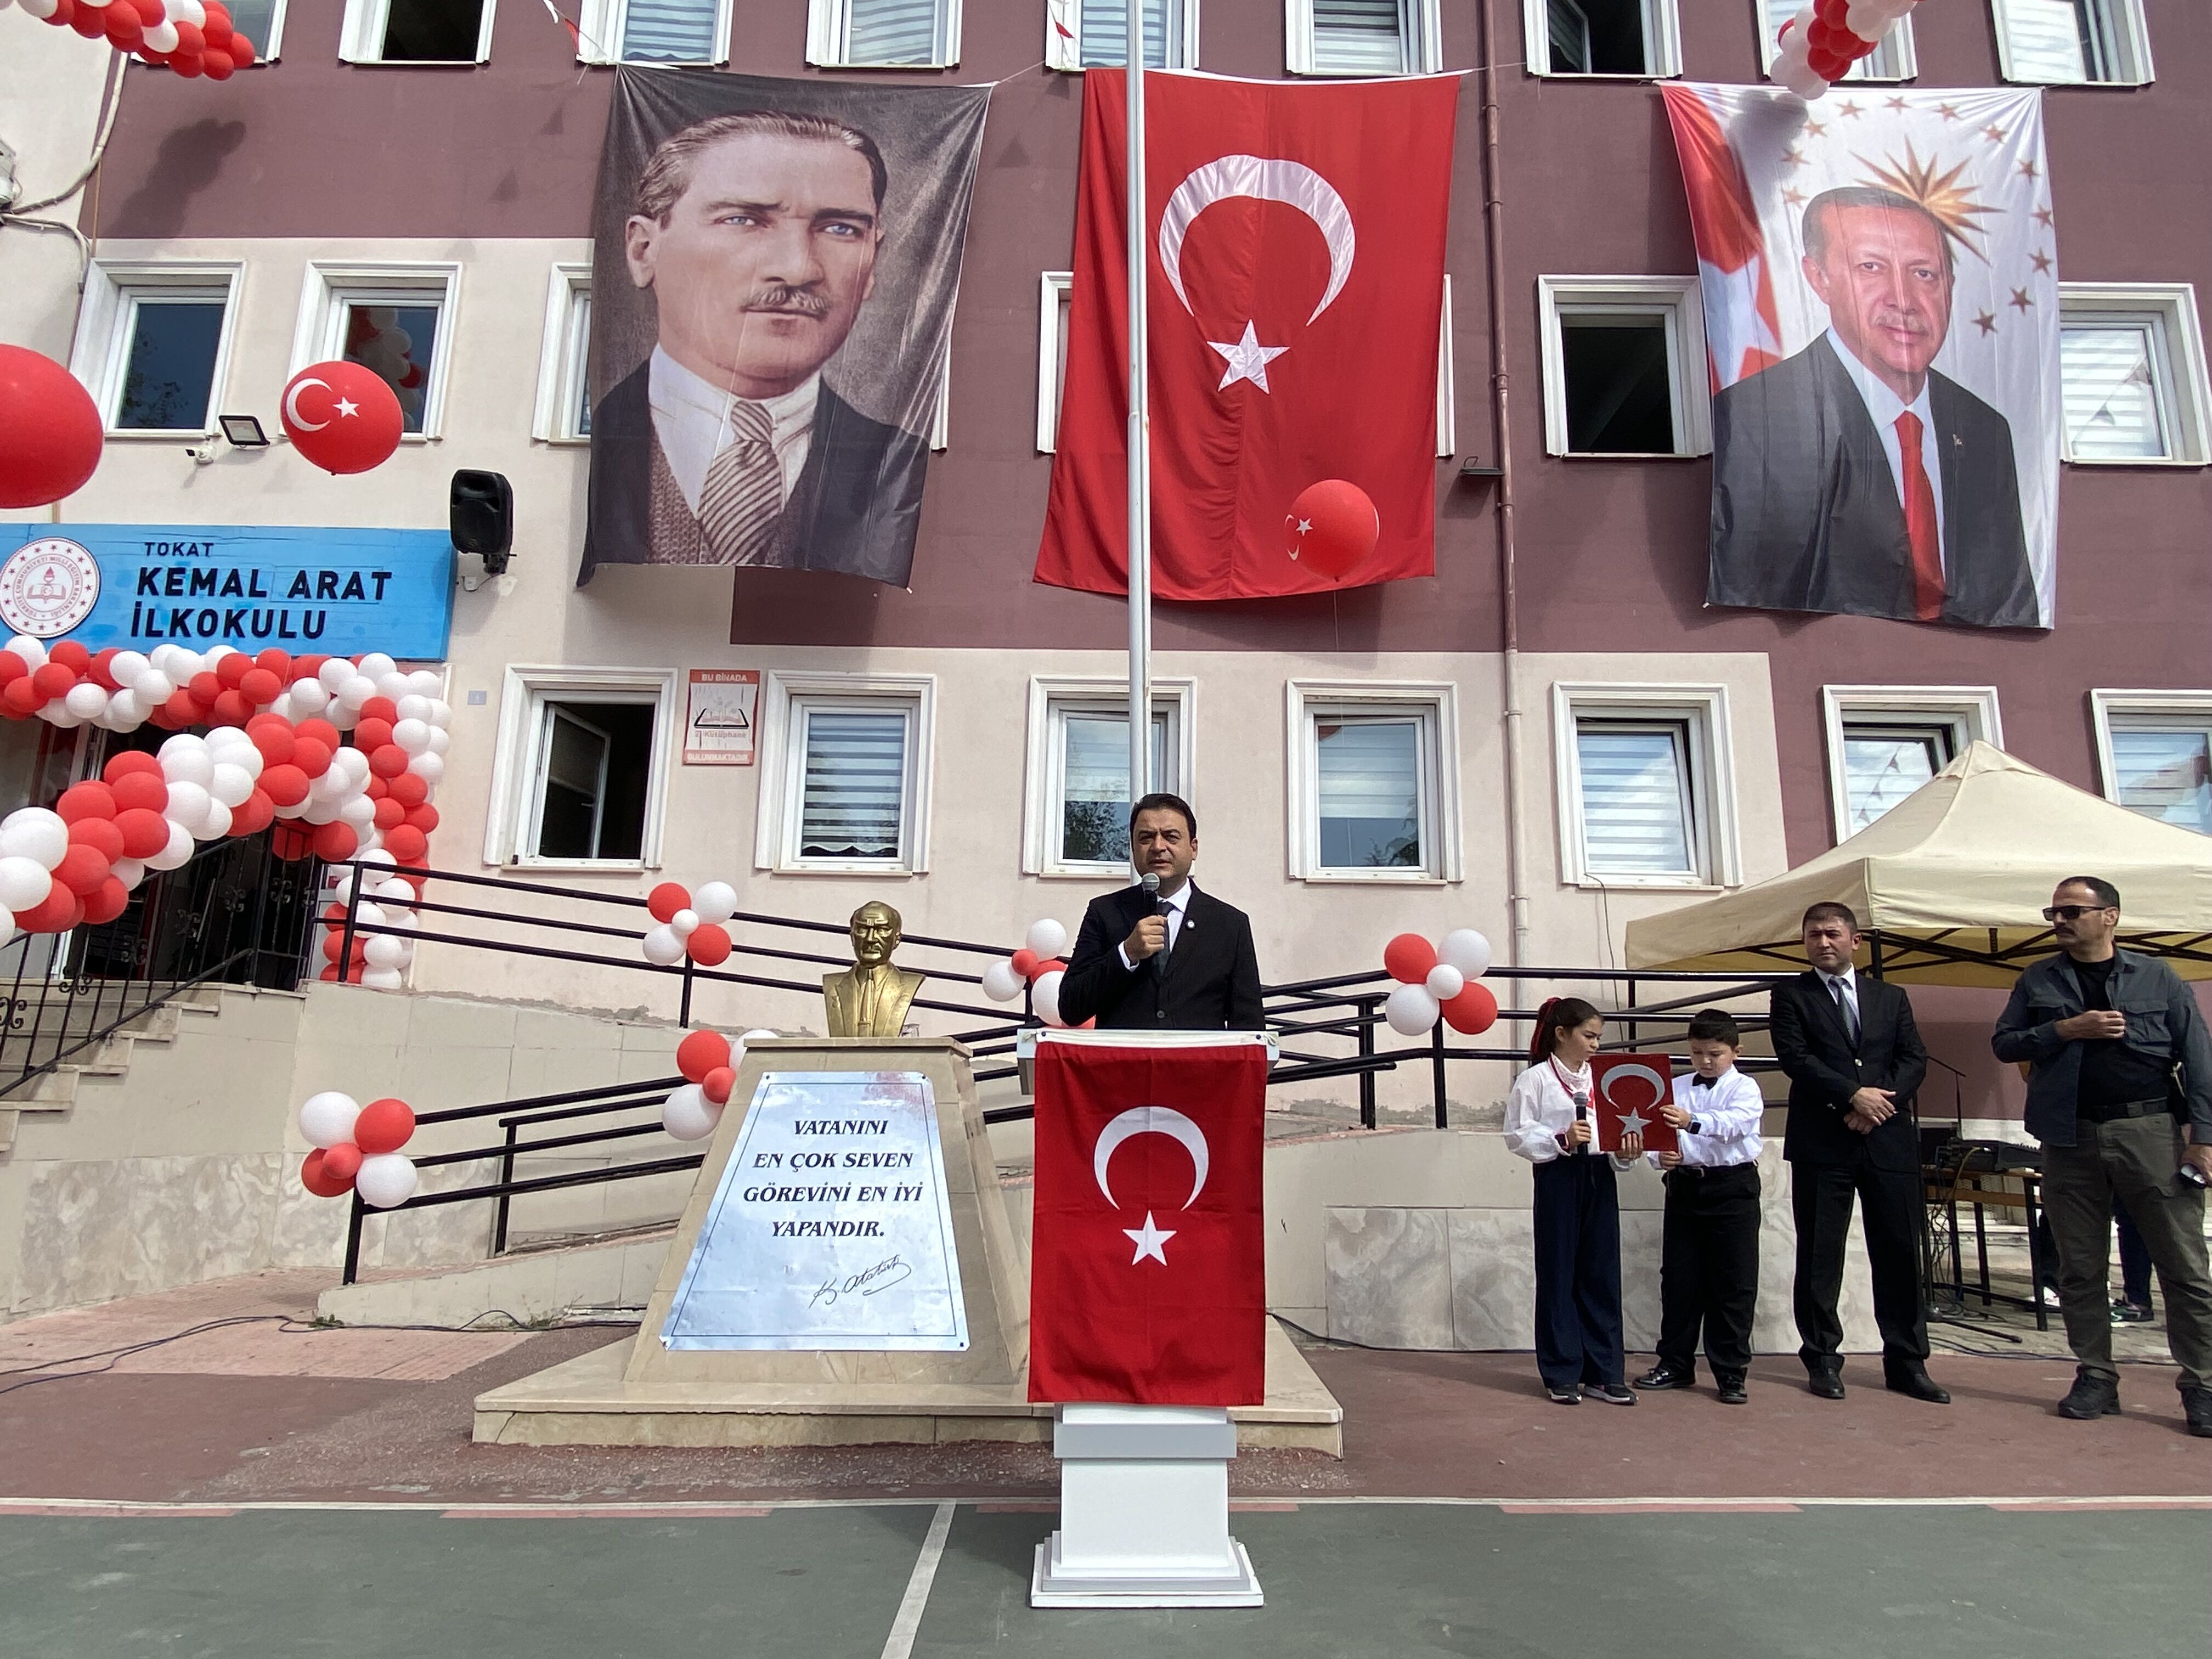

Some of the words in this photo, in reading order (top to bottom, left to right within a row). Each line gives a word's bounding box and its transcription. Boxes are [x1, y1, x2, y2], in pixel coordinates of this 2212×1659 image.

[144, 542, 215, 557] TOKAT
[137, 567, 268, 598] KEMAL
[286, 569, 392, 600] ARAT
[131, 601, 326, 639] İLKOKULU
[794, 1120, 889, 1135] VATANINI
[752, 1153, 784, 1168] EN
[789, 1153, 838, 1172] ÇOK
[842, 1153, 913, 1168] SEVEN
[743, 1182, 852, 1202] GÖREVİNİ
[856, 1186, 888, 1201] EN
[893, 1181, 923, 1201] İYİ
[772, 1221, 885, 1237] YAPANDIR.
